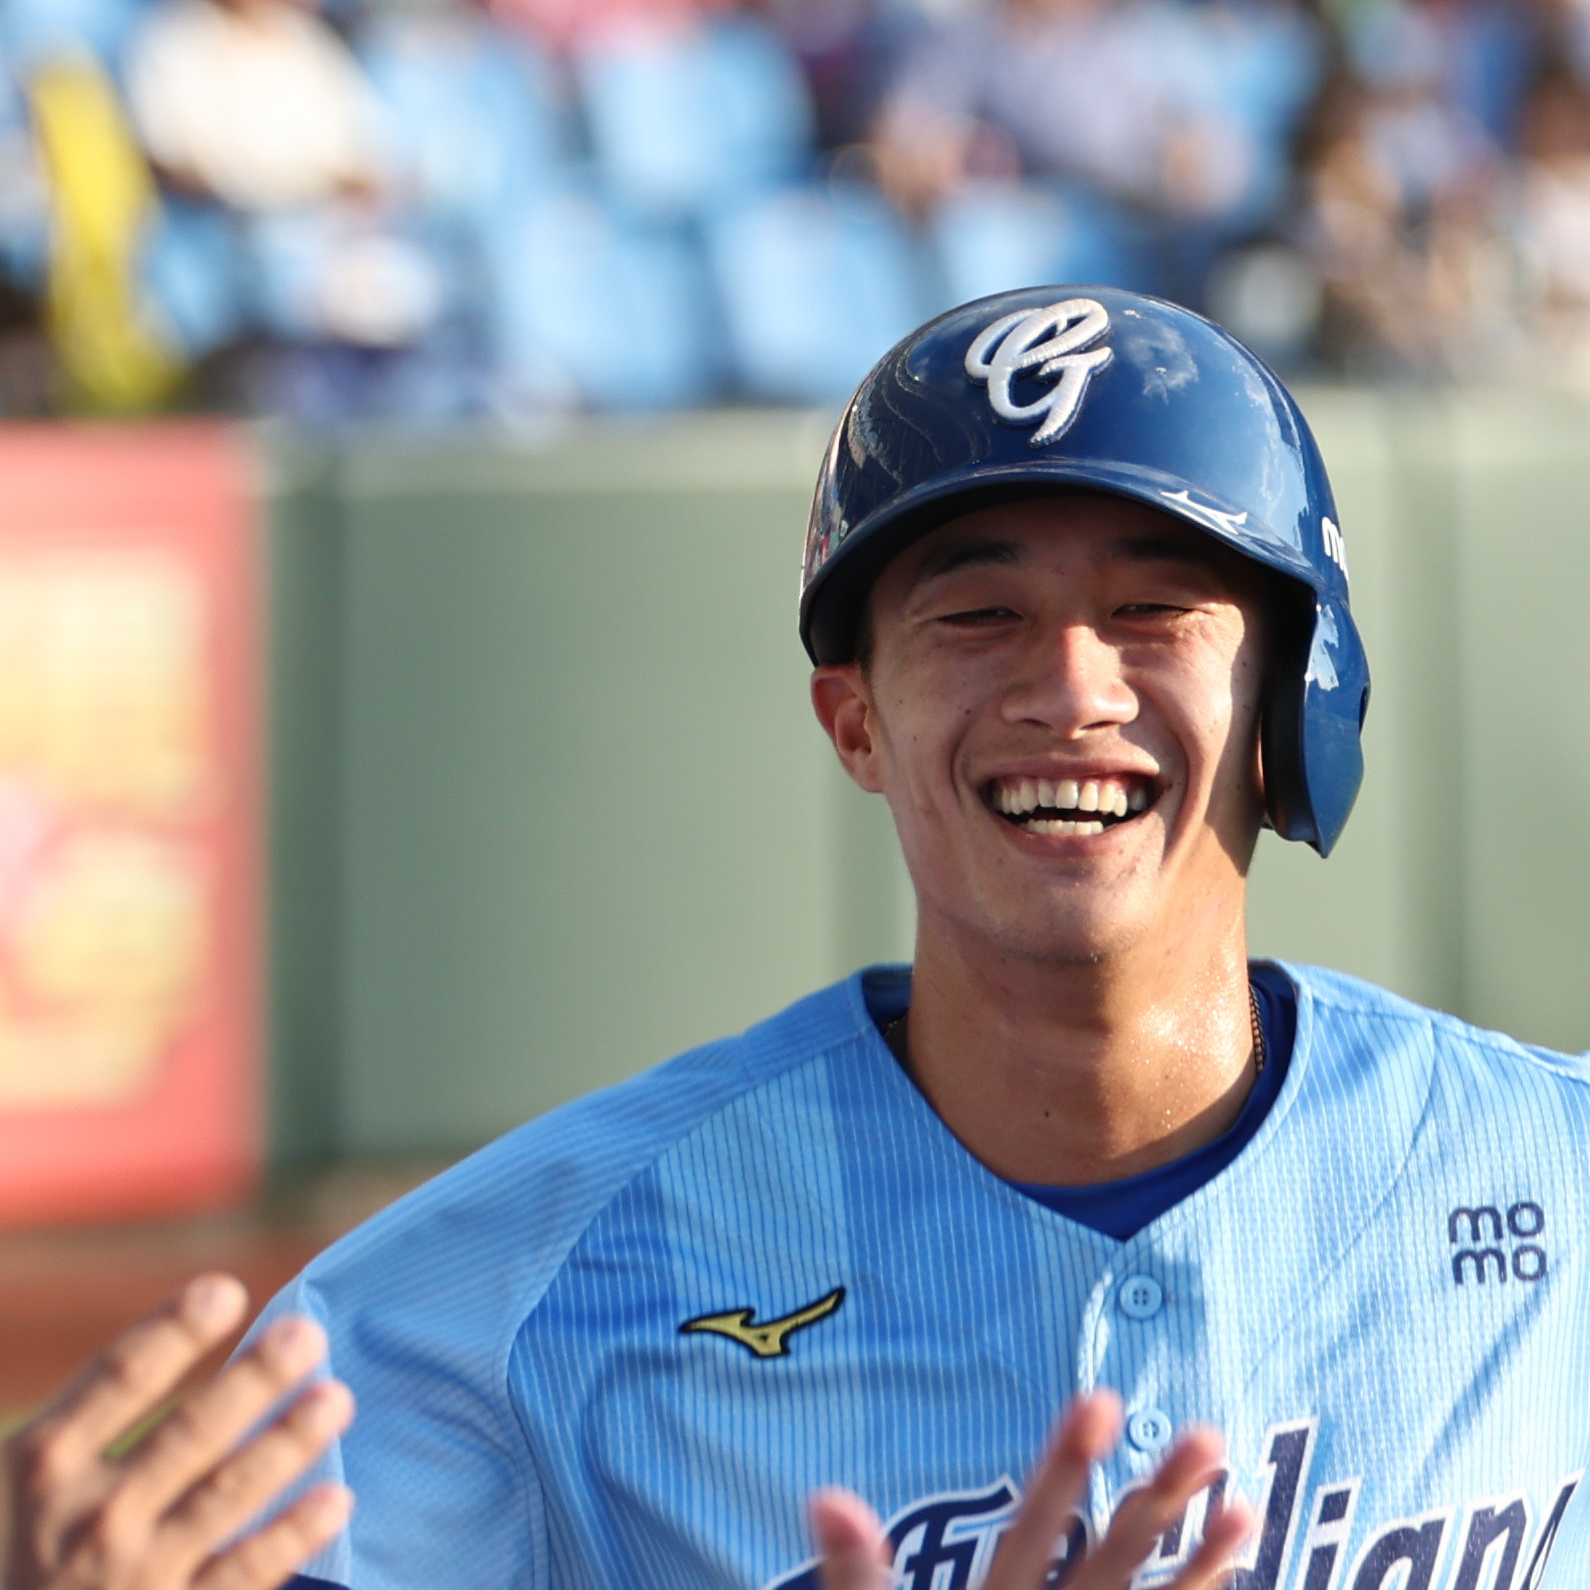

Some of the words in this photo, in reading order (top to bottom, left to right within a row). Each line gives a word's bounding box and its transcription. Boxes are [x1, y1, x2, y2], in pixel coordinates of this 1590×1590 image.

[964, 298, 1113, 447] G
[1448, 1202, 1545, 1244] mo
[1452, 1246, 1547, 1285] mo
